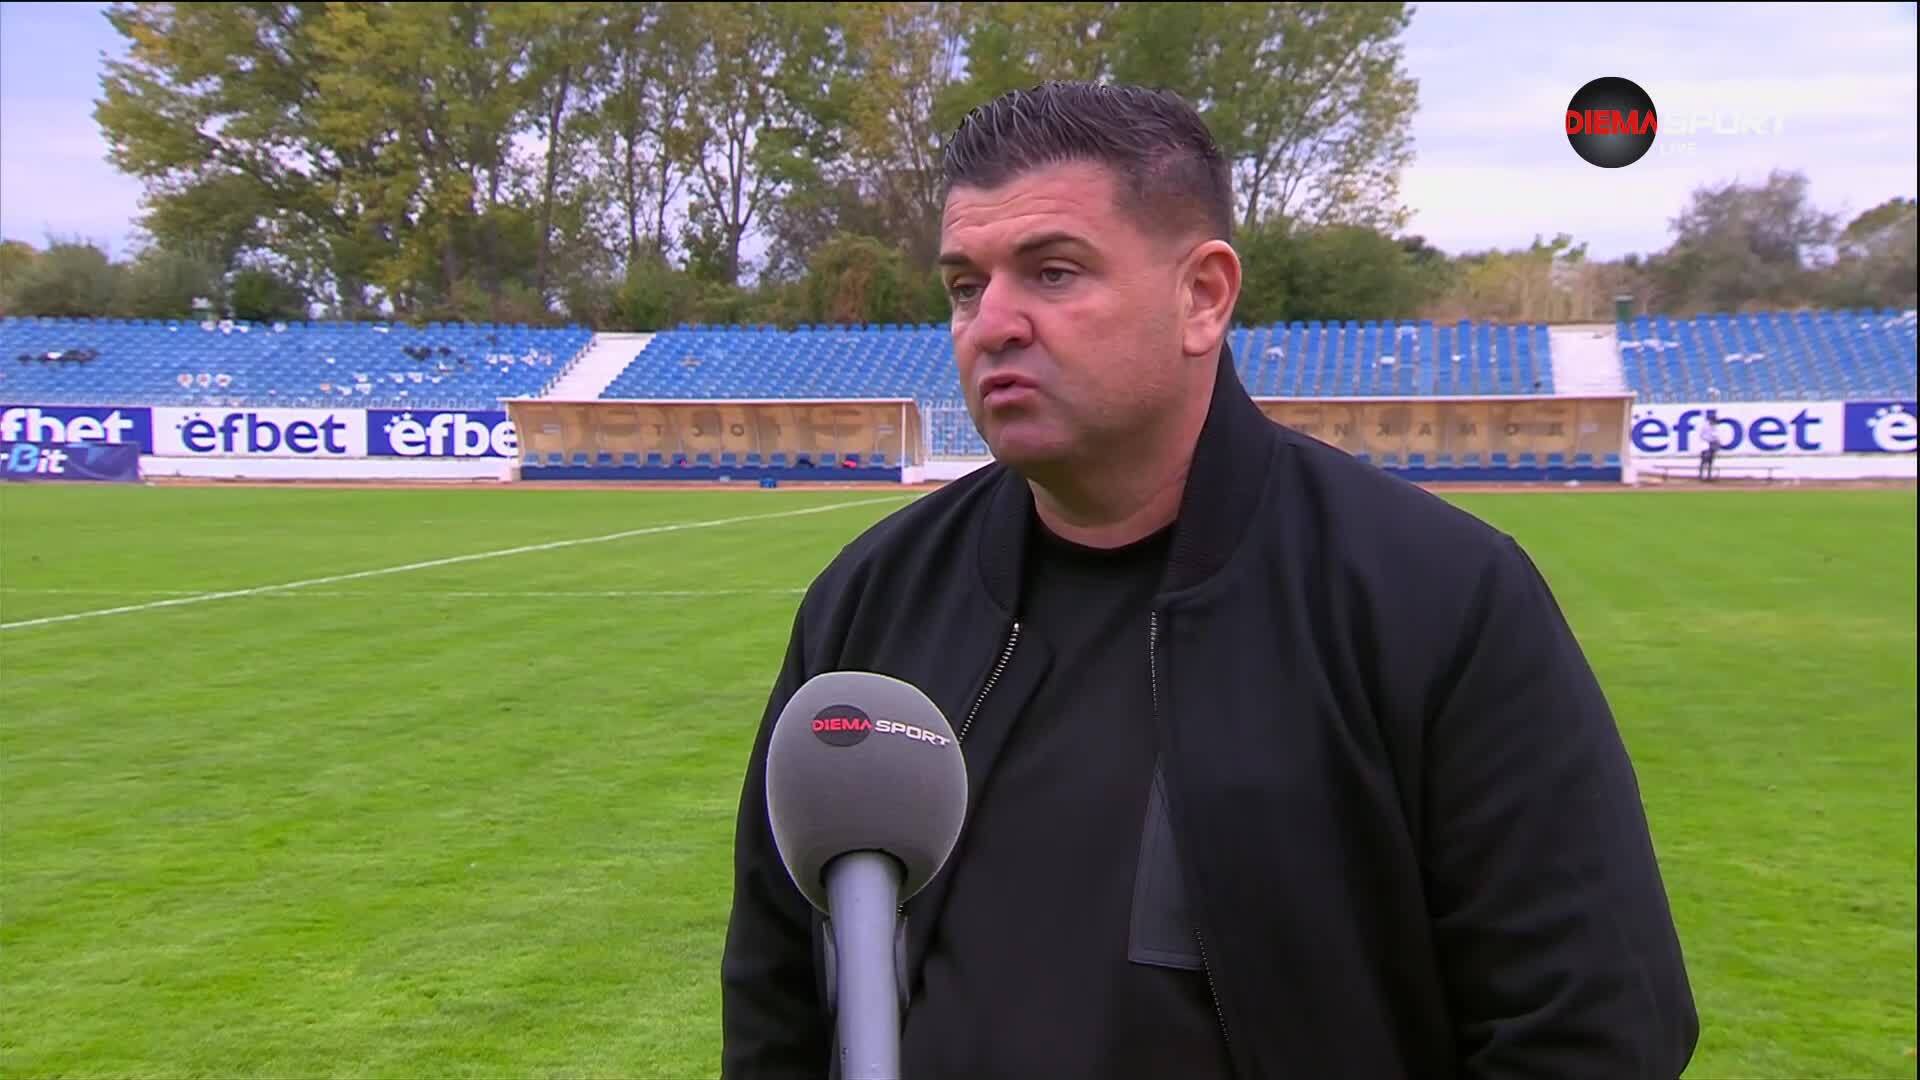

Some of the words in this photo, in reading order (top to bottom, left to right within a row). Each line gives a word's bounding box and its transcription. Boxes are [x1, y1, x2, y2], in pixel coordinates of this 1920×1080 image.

[180, 413, 347, 453] efbet
[388, 411, 519, 456] efbe
[0, 443, 69, 473] Bit
[812, 718, 873, 732] DIEMA
[874, 719, 951, 747] SPORT
